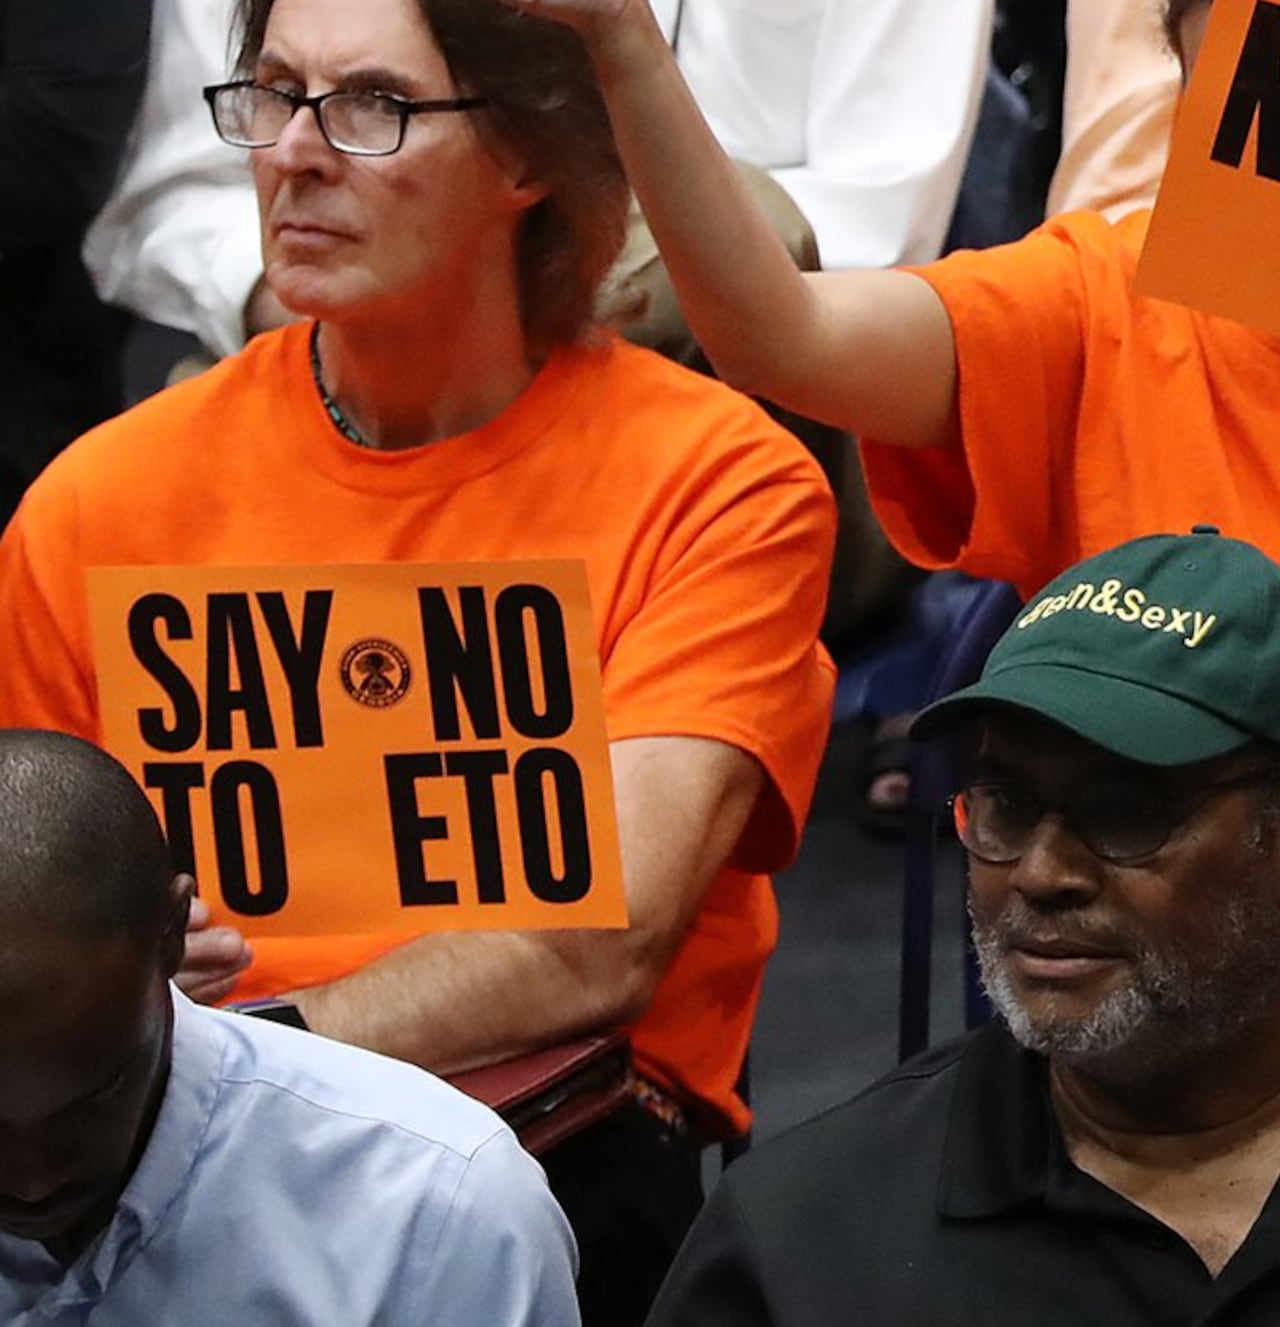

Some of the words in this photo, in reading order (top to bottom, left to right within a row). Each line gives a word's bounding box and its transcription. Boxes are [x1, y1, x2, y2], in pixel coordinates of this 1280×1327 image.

[127, 589, 333, 753] SAY
[418, 584, 573, 741] NO
[143, 761, 288, 916] TO
[384, 748, 591, 906] ETO
